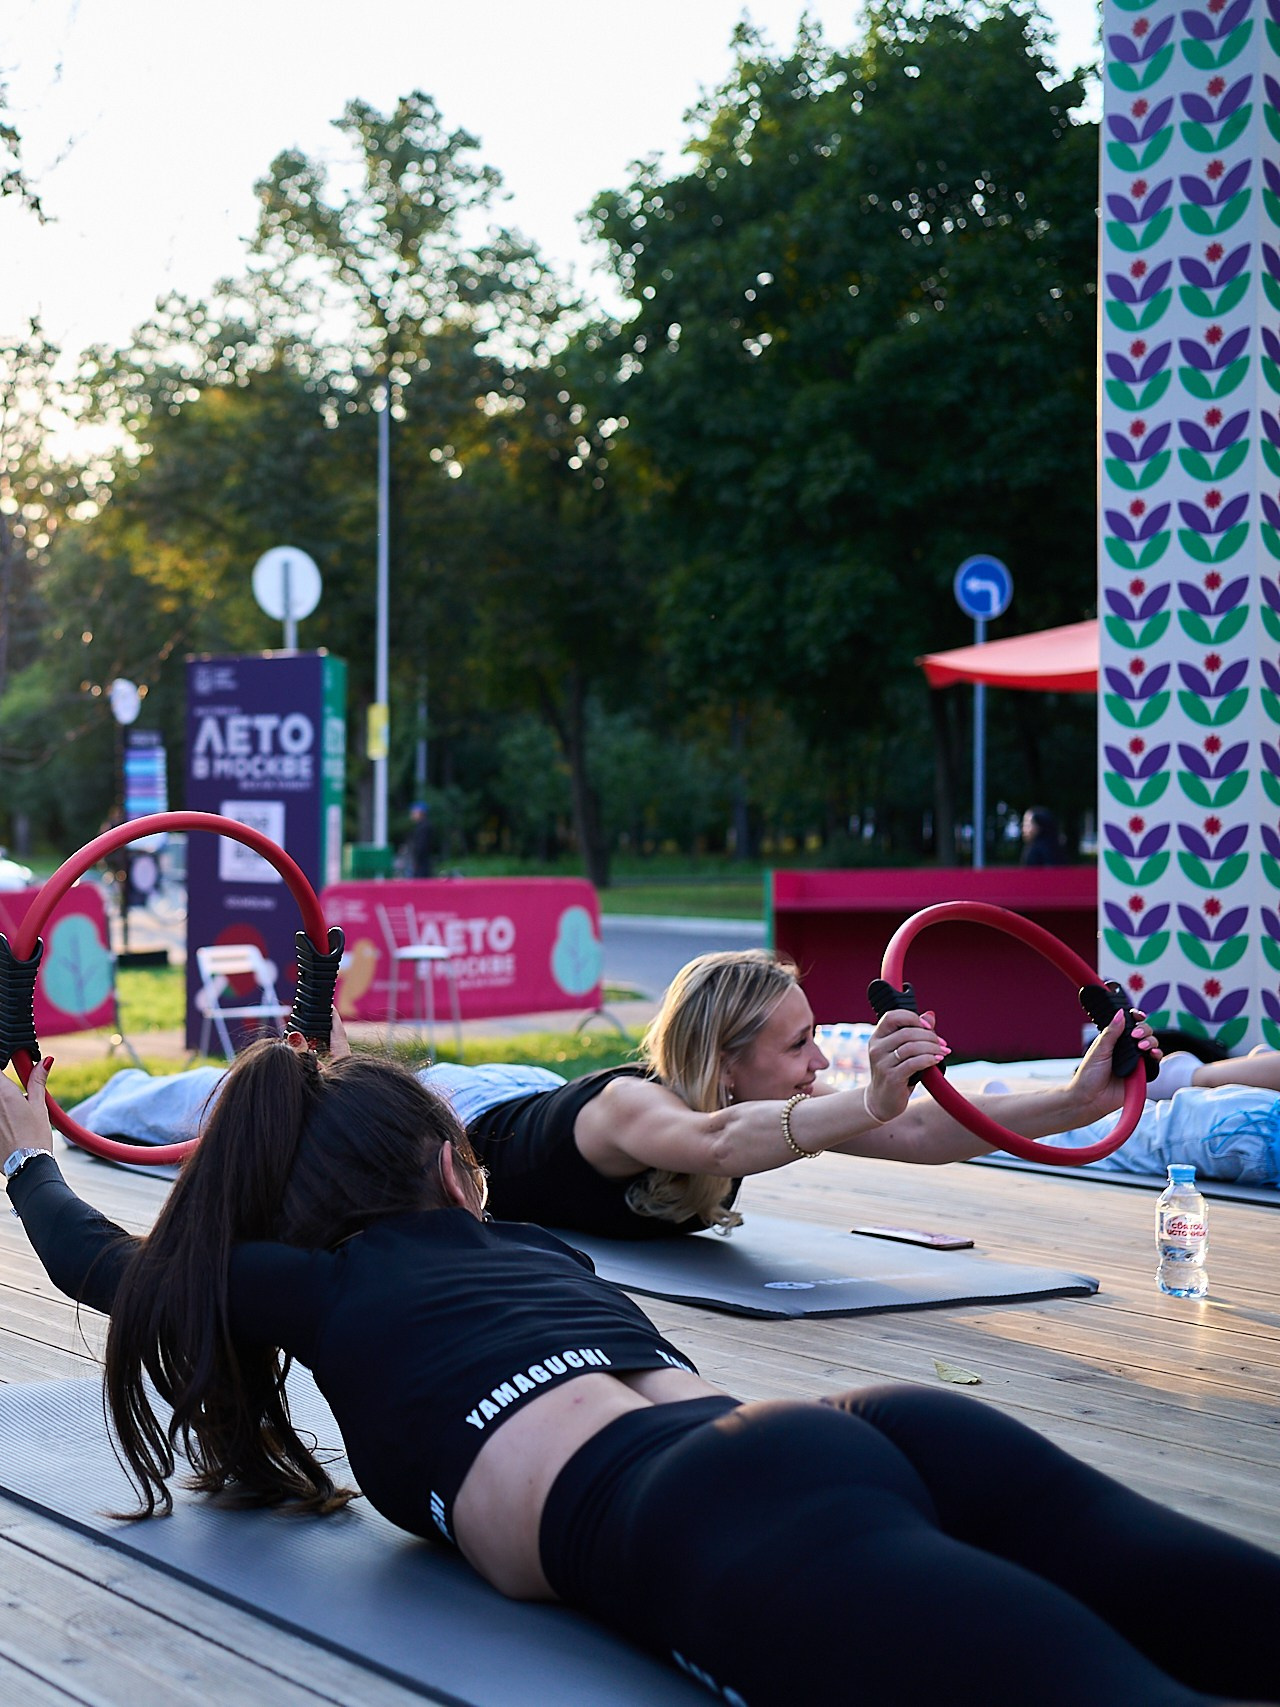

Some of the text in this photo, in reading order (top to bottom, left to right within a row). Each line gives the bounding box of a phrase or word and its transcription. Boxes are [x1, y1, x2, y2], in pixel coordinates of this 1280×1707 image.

[194, 714, 313, 753] ЛЕТО
[213, 755, 313, 779] МОСКВЕ
[1166, 1229, 1206, 1237] истоник
[465, 1348, 612, 1430] YAMAGUCHI
